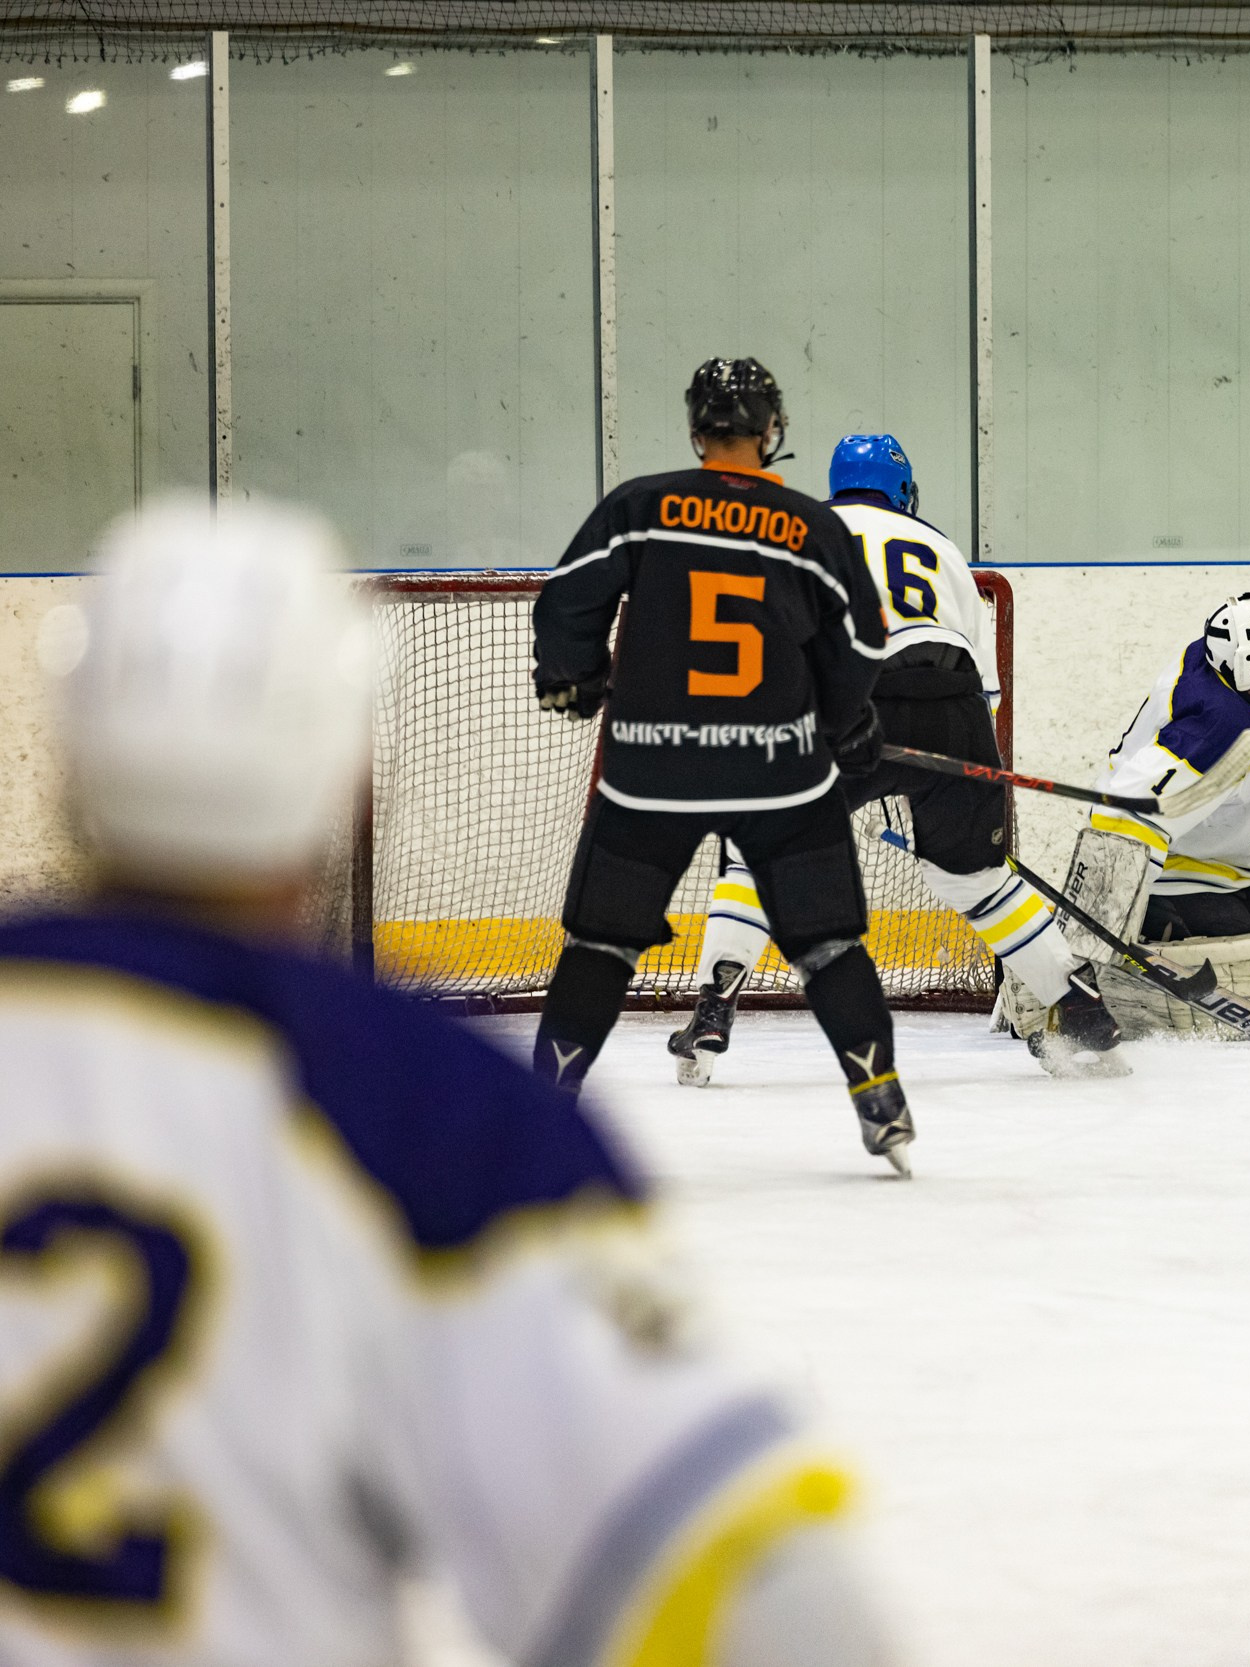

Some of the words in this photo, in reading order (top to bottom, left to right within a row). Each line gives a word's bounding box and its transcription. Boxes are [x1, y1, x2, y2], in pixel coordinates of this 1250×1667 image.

[660, 494, 808, 552] СОКОЛОВ
[688, 570, 766, 697] 5
[1151, 768, 1177, 796] 1
[0, 1185, 205, 1612] 2
